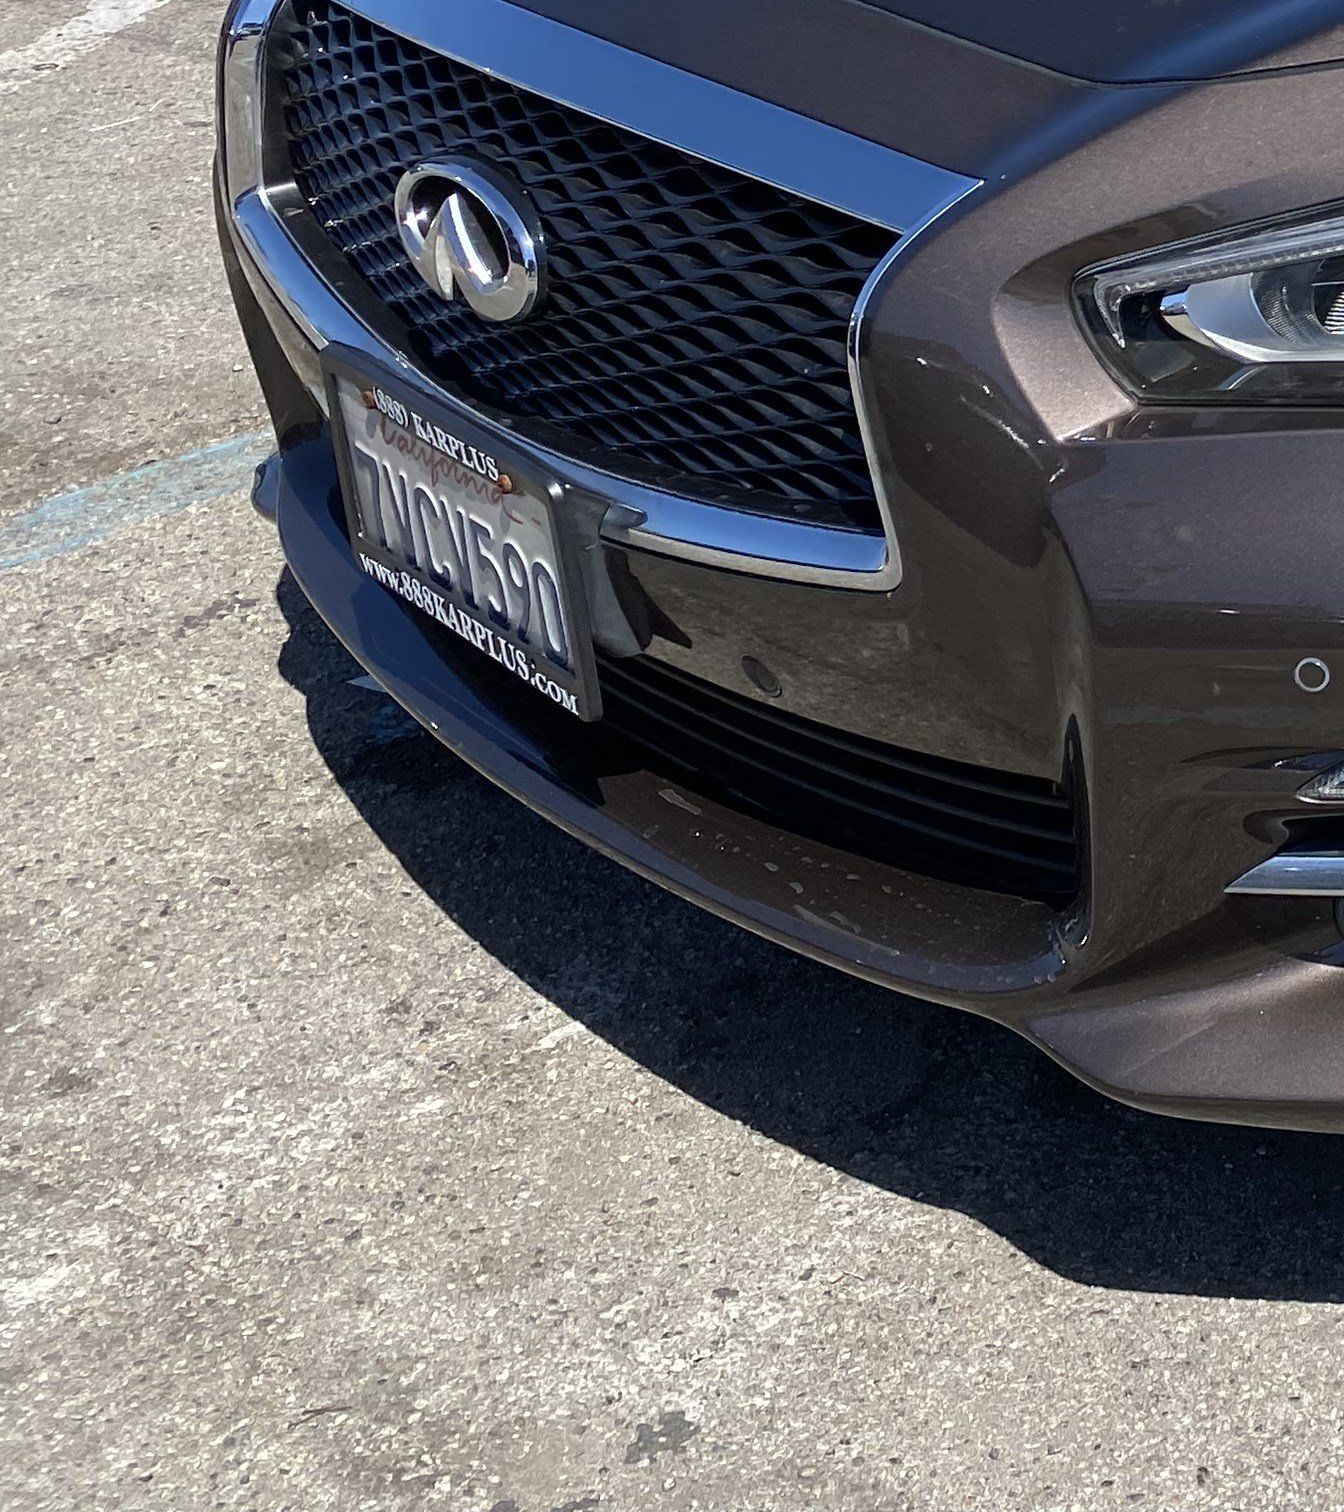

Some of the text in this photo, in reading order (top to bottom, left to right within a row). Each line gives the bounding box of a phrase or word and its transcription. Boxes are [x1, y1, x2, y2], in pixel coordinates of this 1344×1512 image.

[373, 386, 499, 482] (888) KARPLUS
[354, 440, 569, 668] 7NCV590
